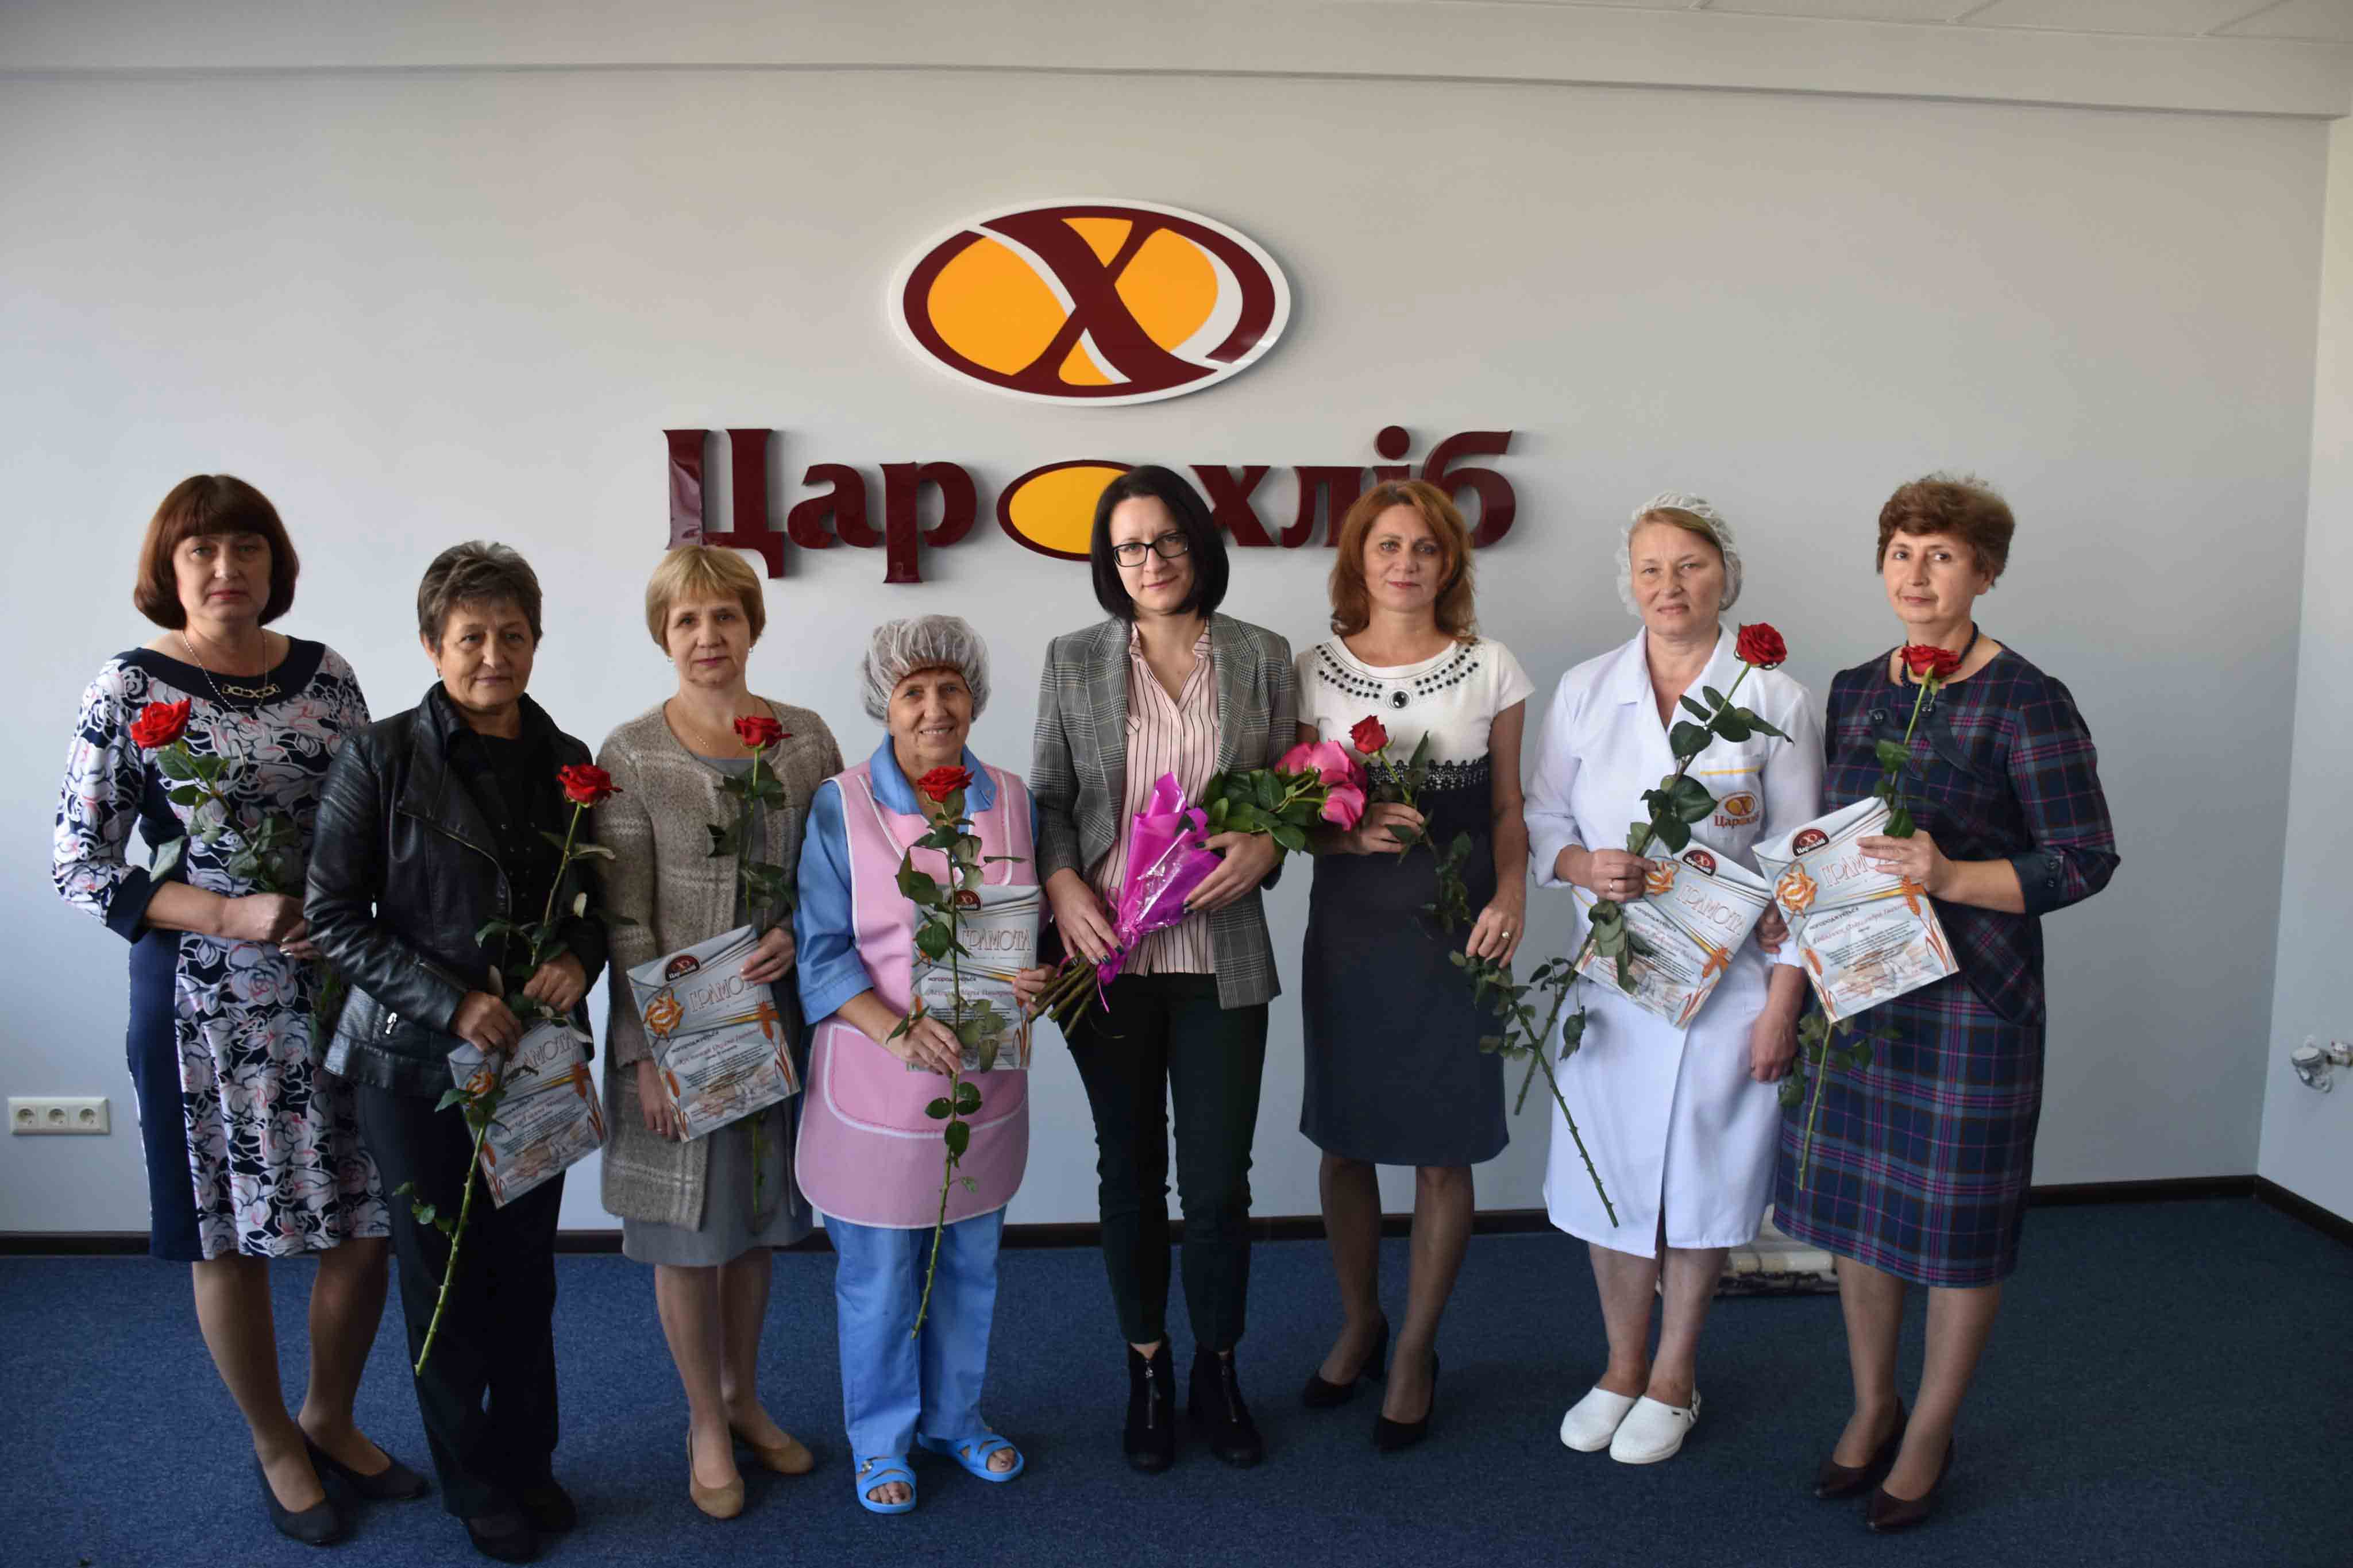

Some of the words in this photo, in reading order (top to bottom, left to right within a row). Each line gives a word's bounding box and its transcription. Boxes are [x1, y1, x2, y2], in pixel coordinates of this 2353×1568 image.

[662, 428, 977, 584] Цар
[962, 928, 1032, 951] ГРАМОТА
[689, 975, 755, 1013] ГРАМО
